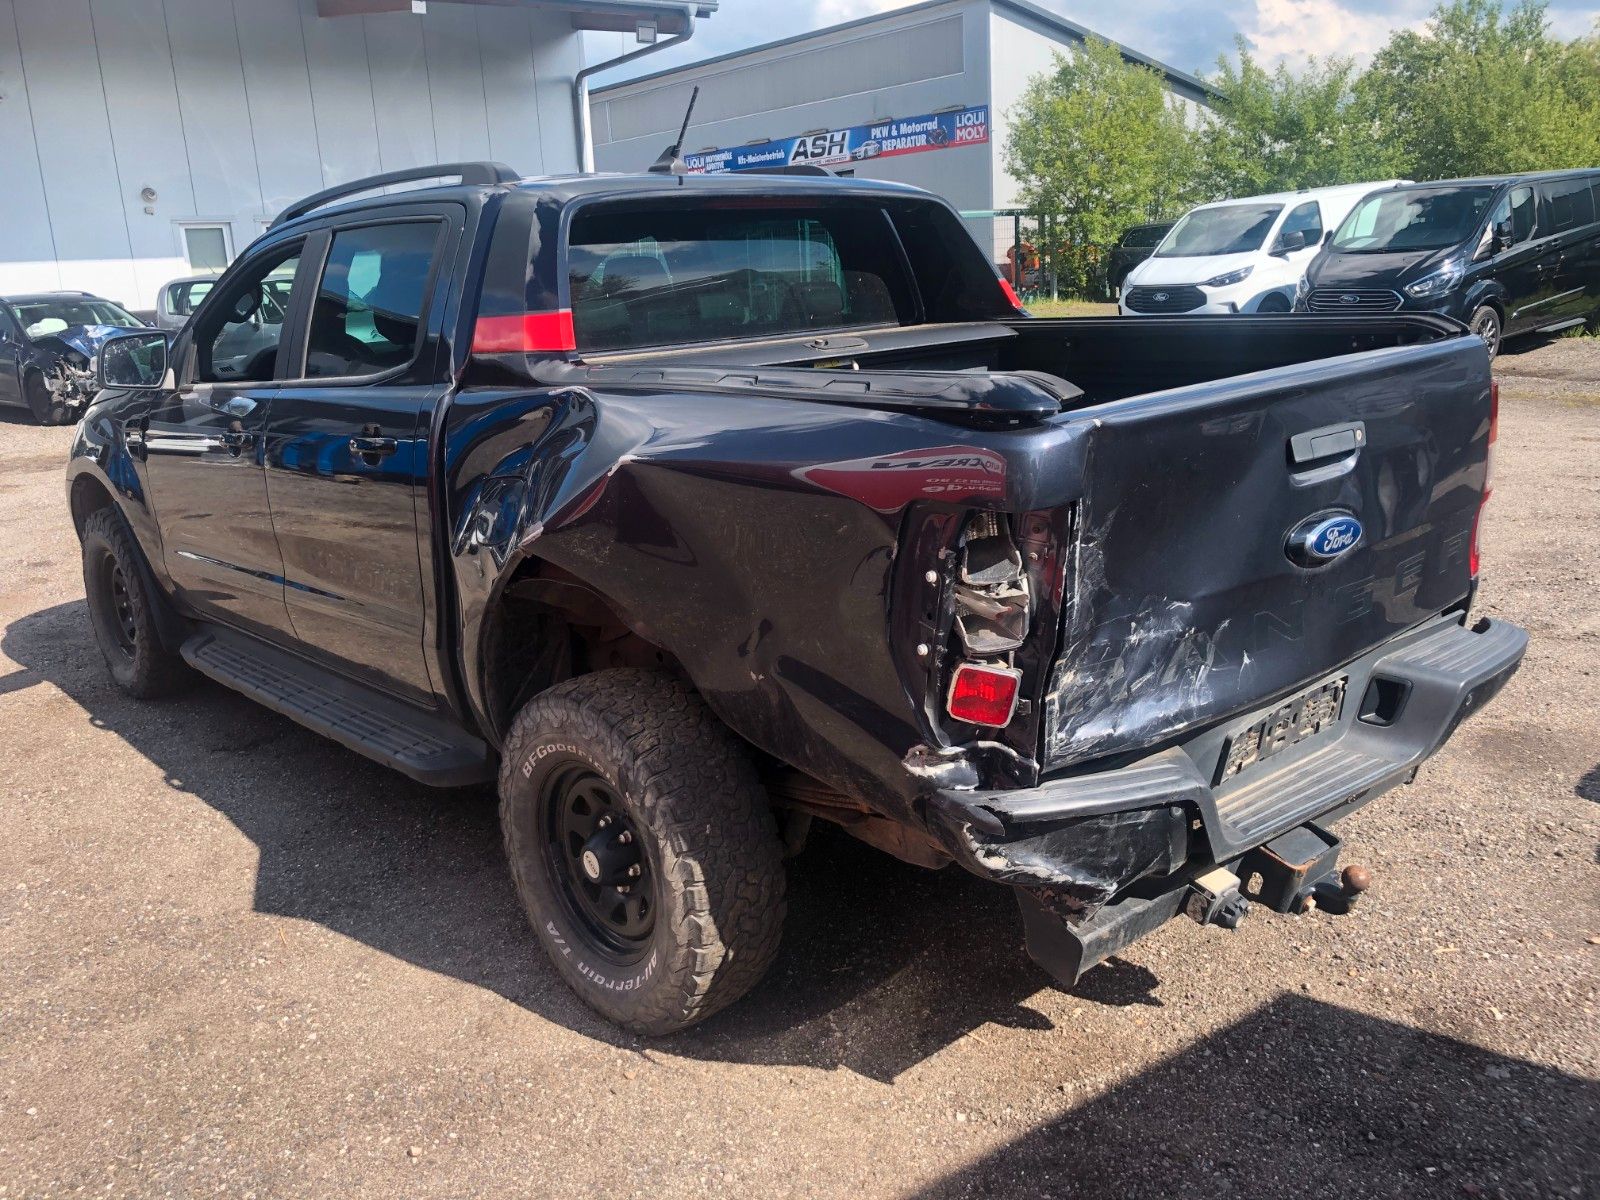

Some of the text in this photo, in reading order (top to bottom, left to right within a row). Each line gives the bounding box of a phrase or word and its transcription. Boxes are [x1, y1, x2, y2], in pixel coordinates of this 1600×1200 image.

[871, 117, 938, 139] PKW & Motorrad
[956, 112, 985, 128] LIQUI
[881, 134, 928, 152] REPARATUR
[956, 125, 986, 142] MOLY
[791, 131, 847, 161] ASH
[1323, 524, 1354, 552] Ford
